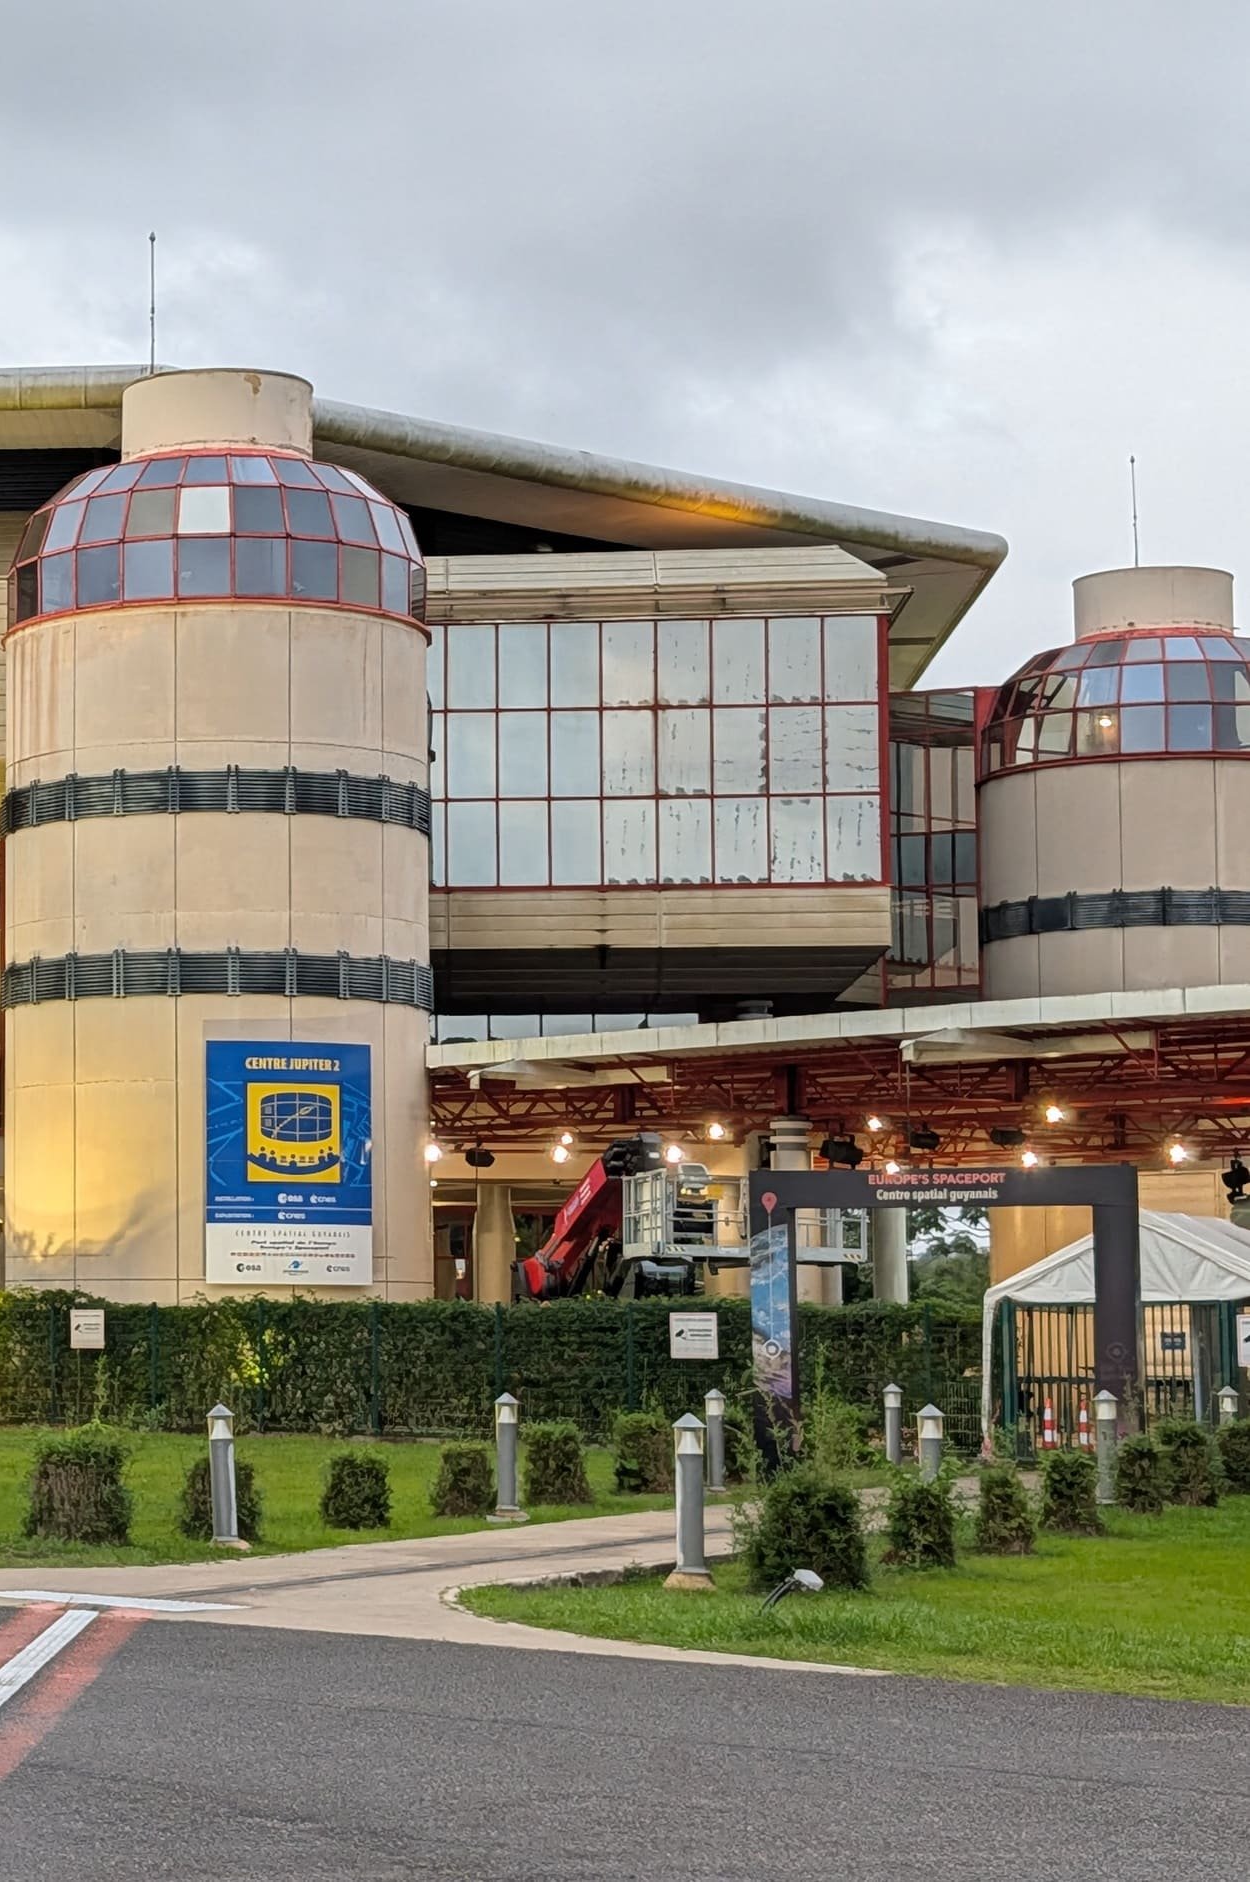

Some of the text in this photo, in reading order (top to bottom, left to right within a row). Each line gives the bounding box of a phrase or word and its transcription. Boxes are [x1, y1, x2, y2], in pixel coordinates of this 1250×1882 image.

[245, 1057, 340, 1072] CENTRE JUPITER 2
[868, 1172, 1006, 1185] EUROPE'S SPACEPORT
[876, 1187, 999, 1203] Centre spatial guyanais
